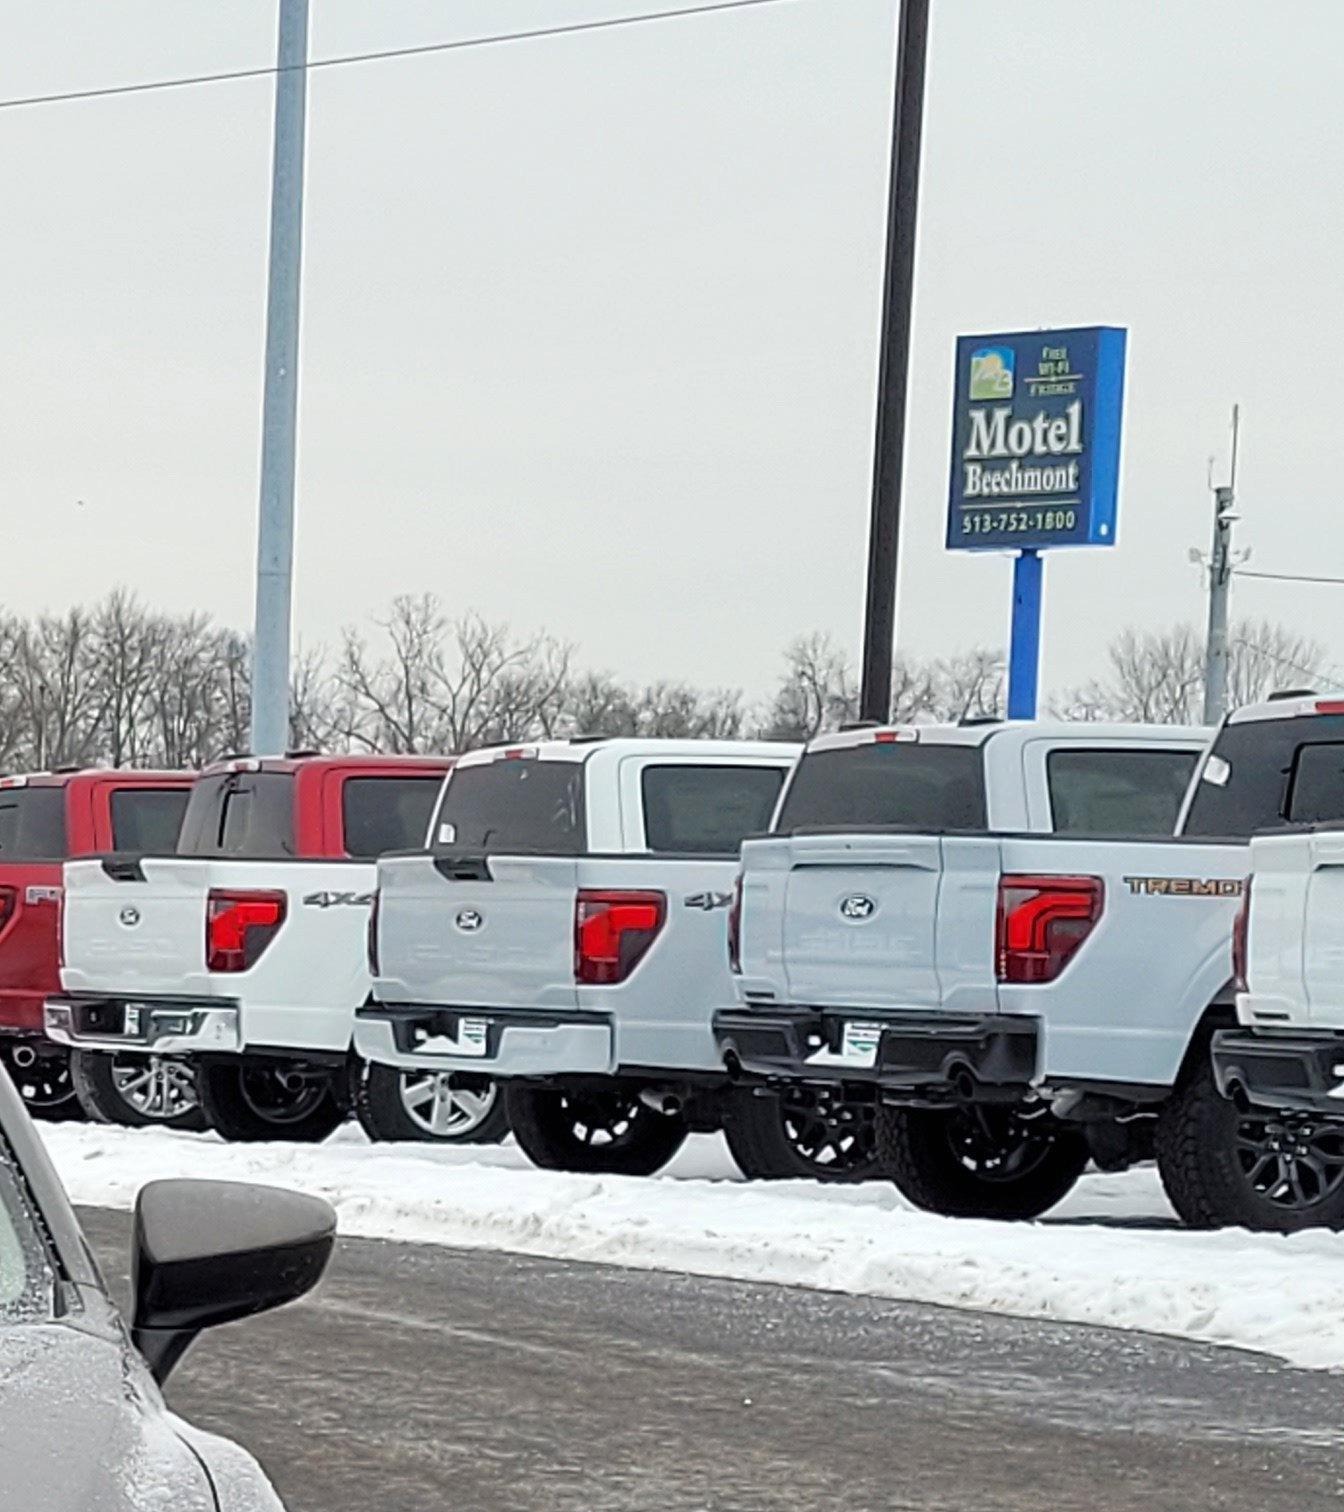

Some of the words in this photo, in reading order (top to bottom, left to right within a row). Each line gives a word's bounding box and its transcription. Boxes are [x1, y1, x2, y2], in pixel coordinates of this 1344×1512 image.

[963, 398, 1082, 459] Motel
[963, 459, 1079, 497] Beechmont
[962, 510, 1075, 534] 513-752-1800
[1123, 876, 1244, 897] TREMO
